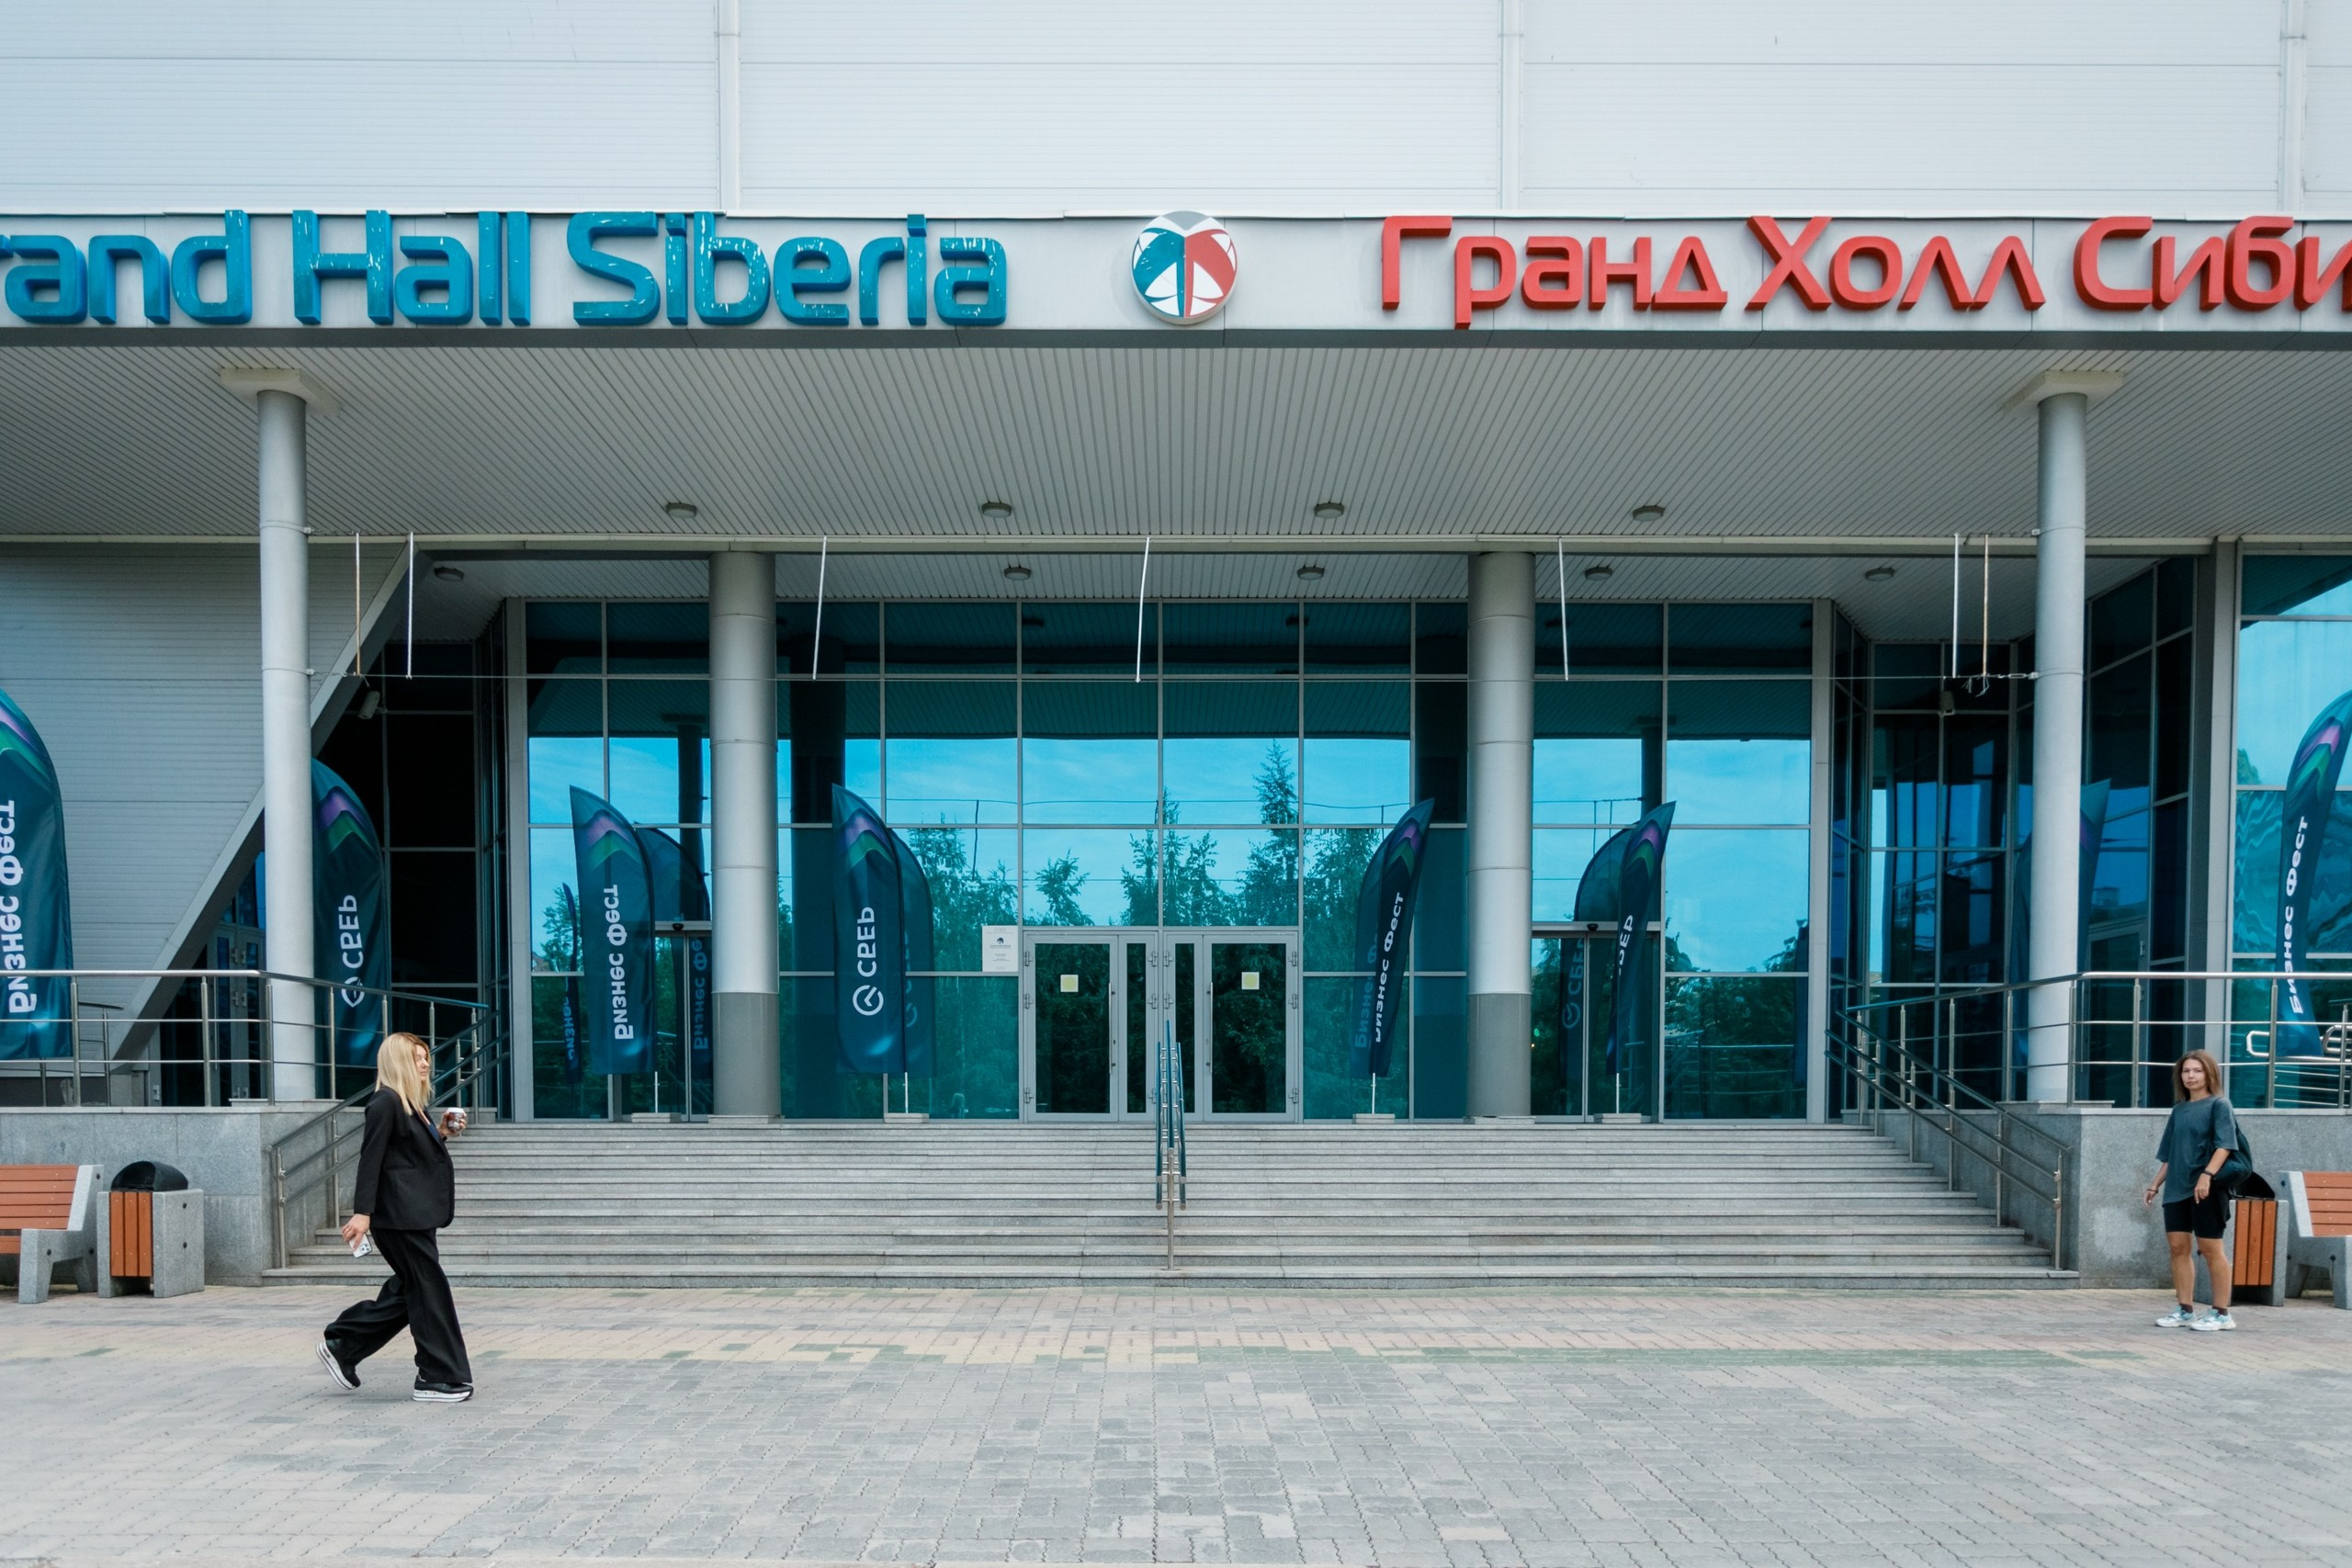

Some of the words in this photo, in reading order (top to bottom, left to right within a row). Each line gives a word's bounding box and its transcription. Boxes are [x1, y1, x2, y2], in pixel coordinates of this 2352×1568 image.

[0, 209, 252, 324] and
[292, 209, 531, 325] Hall
[566, 211, 1007, 325] Siberia
[1381, 215, 1728, 330] Гранд
[1745, 215, 2046, 311] Холл
[2073, 215, 2352, 311] Сиби
[2285, 816, 2308, 897] Фест
[1384, 892, 1404, 953] Фест
[2283, 906, 2304, 1014] Бизнес
